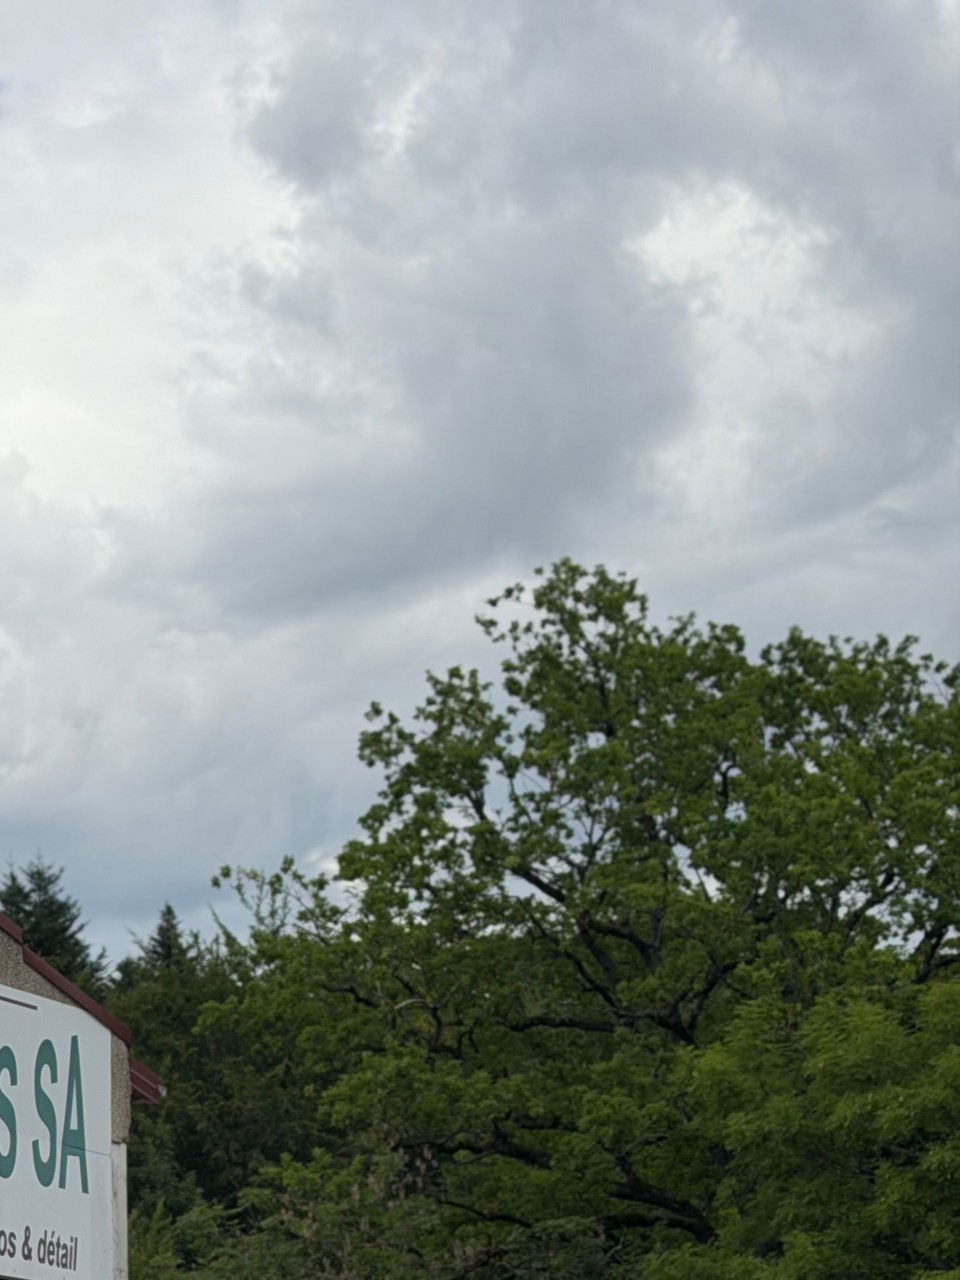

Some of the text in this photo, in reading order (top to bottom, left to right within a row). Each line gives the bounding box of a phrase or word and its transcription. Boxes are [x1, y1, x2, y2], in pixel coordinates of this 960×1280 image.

[31, 1034, 90, 1195] SA
[21, 1224, 33, 1261] &
[37, 1229, 79, 1271] détail
